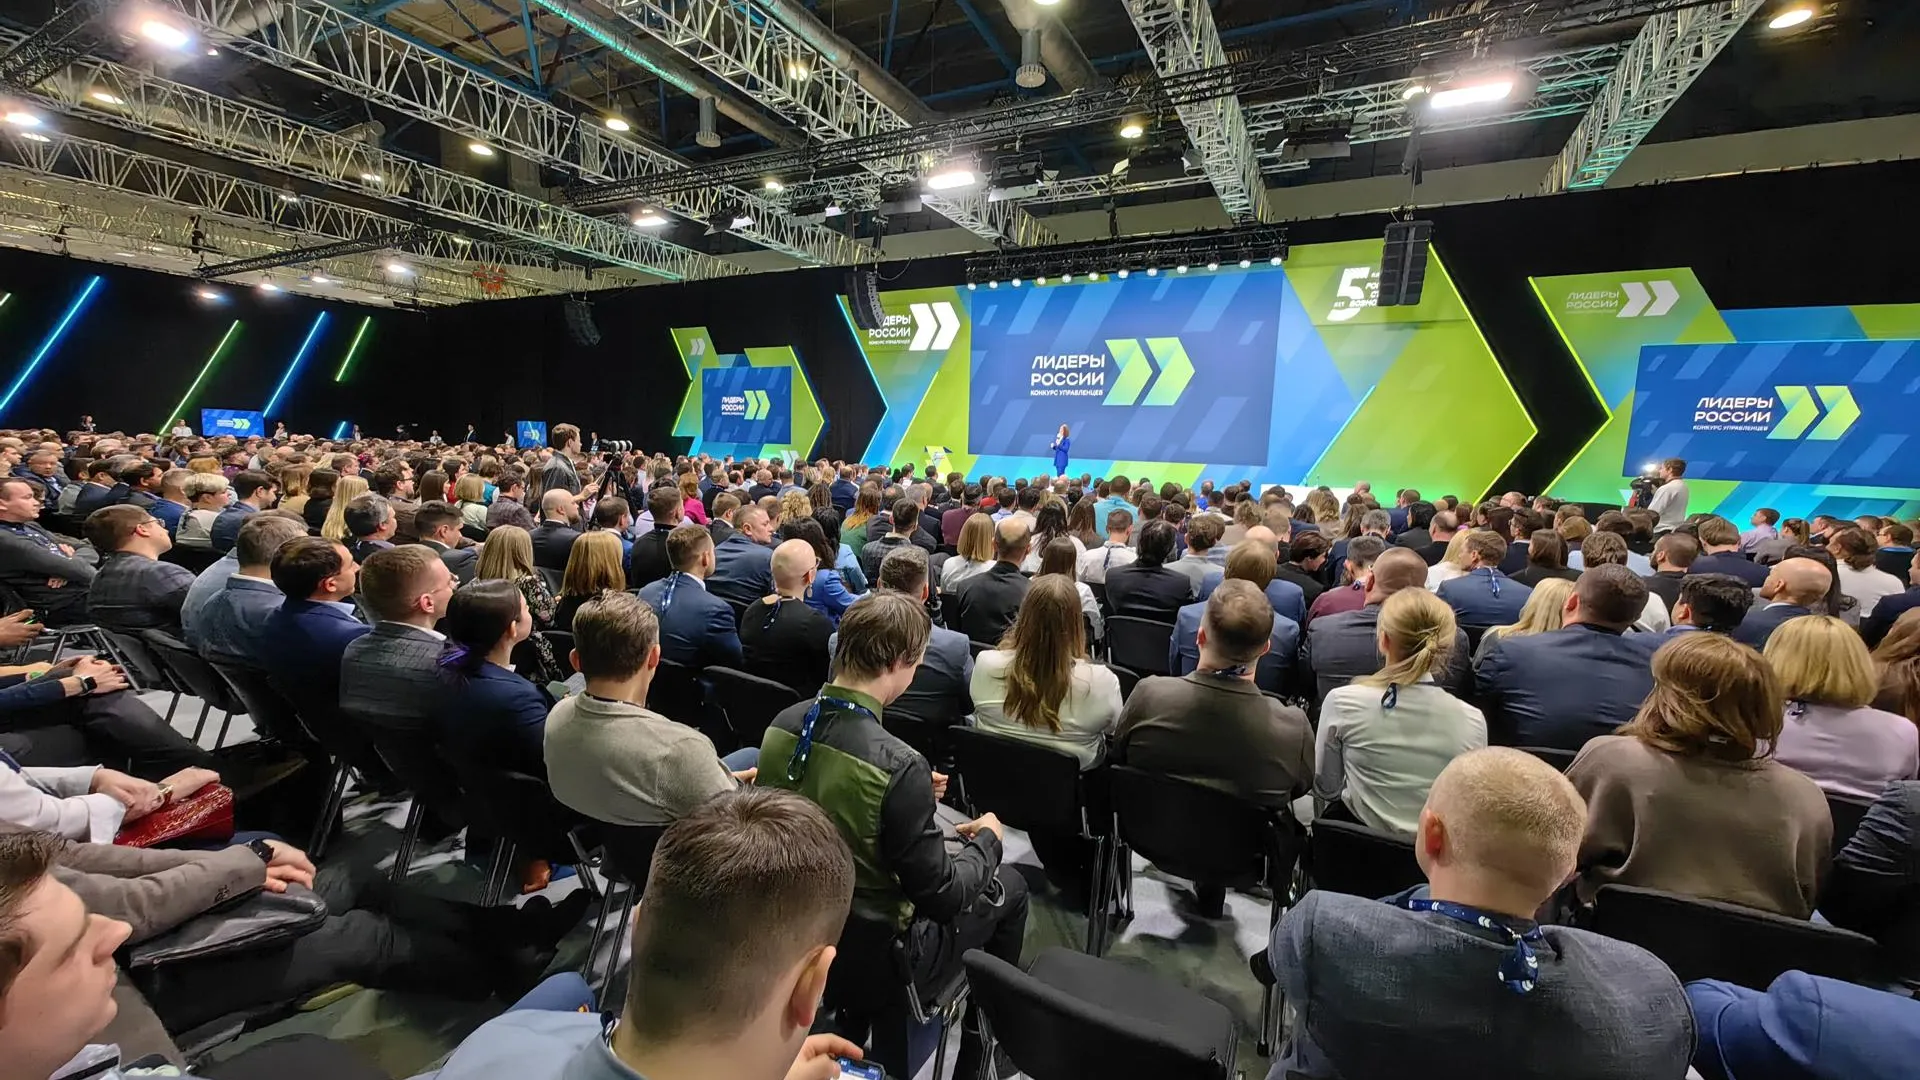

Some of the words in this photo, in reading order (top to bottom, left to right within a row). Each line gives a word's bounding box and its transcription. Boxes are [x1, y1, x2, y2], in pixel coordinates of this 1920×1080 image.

[1326, 266, 1371, 321] 5
[1567, 290, 1619, 300] ЛИДЕРЫ
[1566, 300, 1618, 309] РОССИИ
[882, 315, 911, 326] ДЕРЫ
[868, 327, 911, 338] РОССИИ
[1031, 354, 1105, 370] ЛИДЕРЫ
[1030, 372, 1104, 386] РОССИИ
[721, 404, 745, 412] РОССИИ
[1696, 397, 1774, 410] ЛИДЕРЫ
[1694, 411, 1771, 423] РОССИИ
